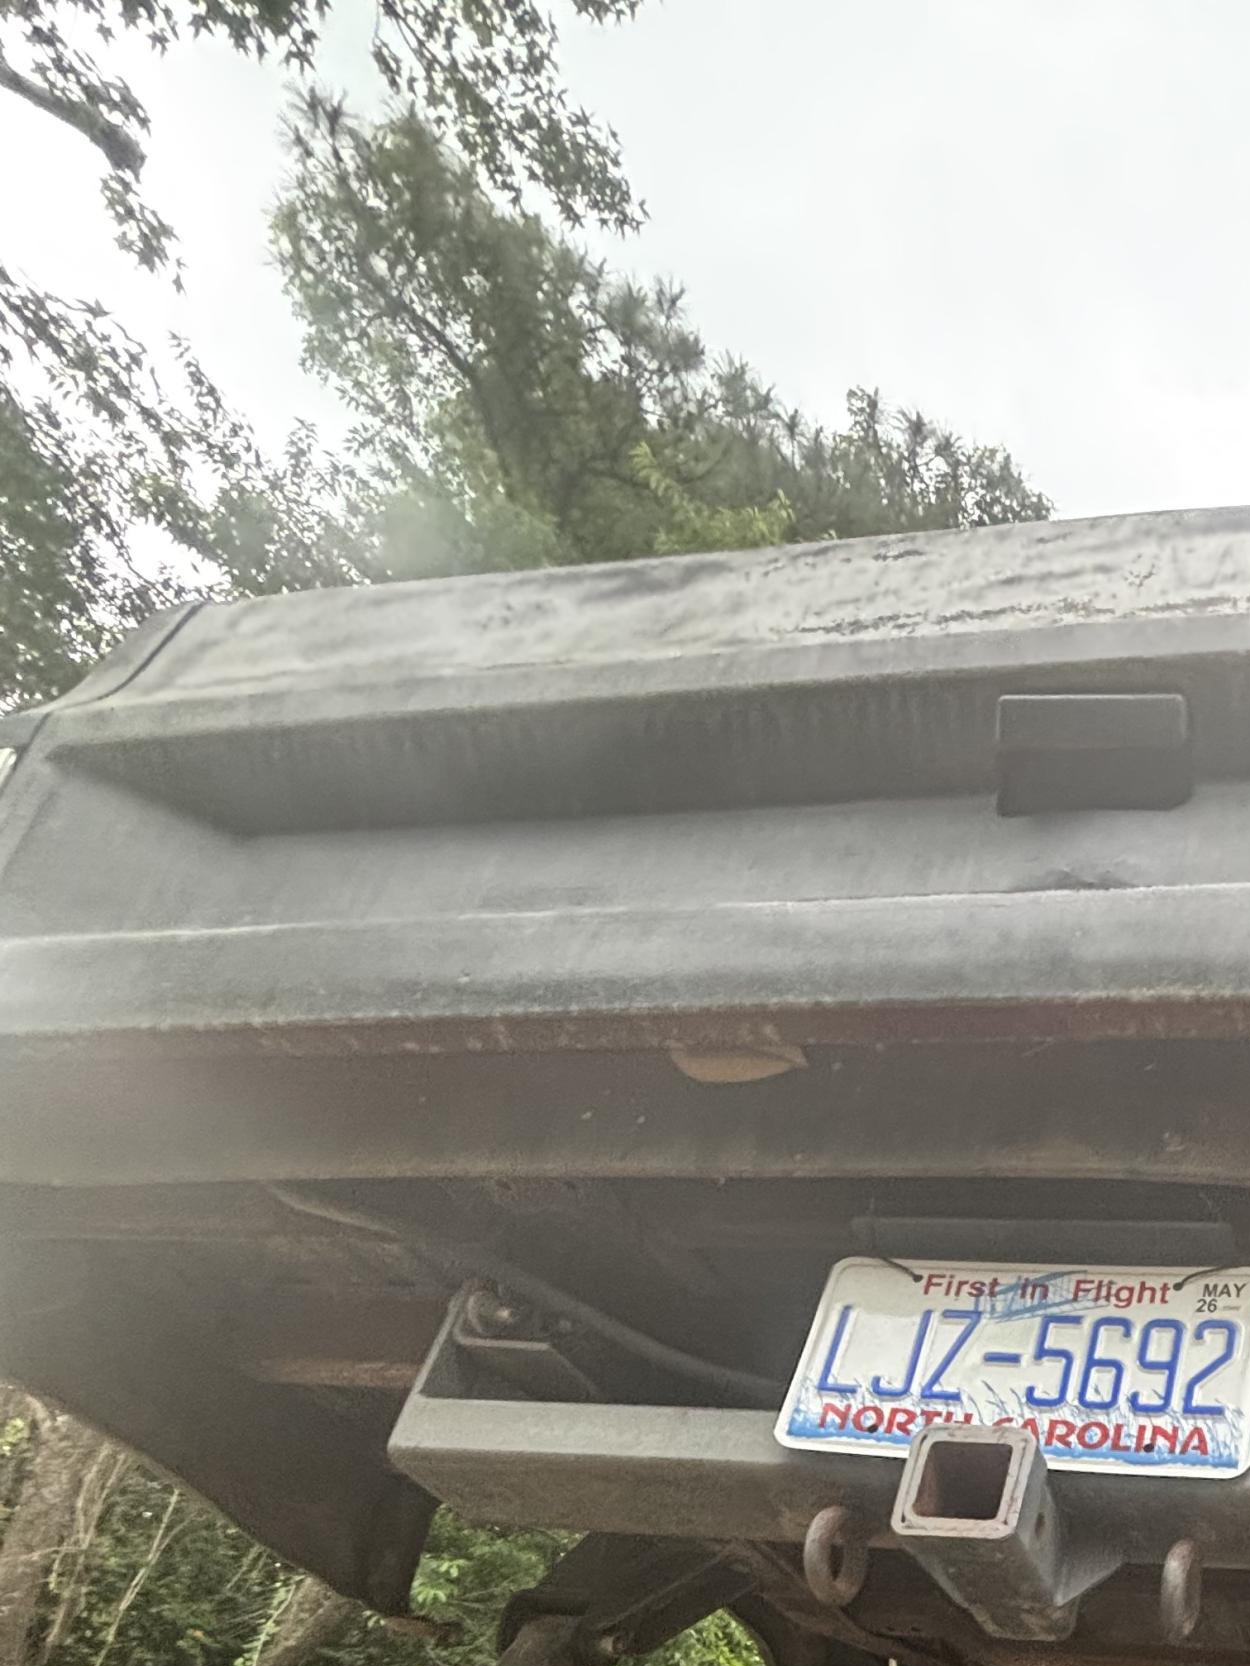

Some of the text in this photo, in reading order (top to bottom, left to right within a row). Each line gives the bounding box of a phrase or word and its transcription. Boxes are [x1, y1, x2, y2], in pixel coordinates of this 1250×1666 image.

[923, 1273, 1171, 1309] First in Flight
[1202, 1283, 1247, 1298] MAY
[1195, 1298, 1218, 1313] 26
[817, 1305, 1237, 1415] LJZ-5692
